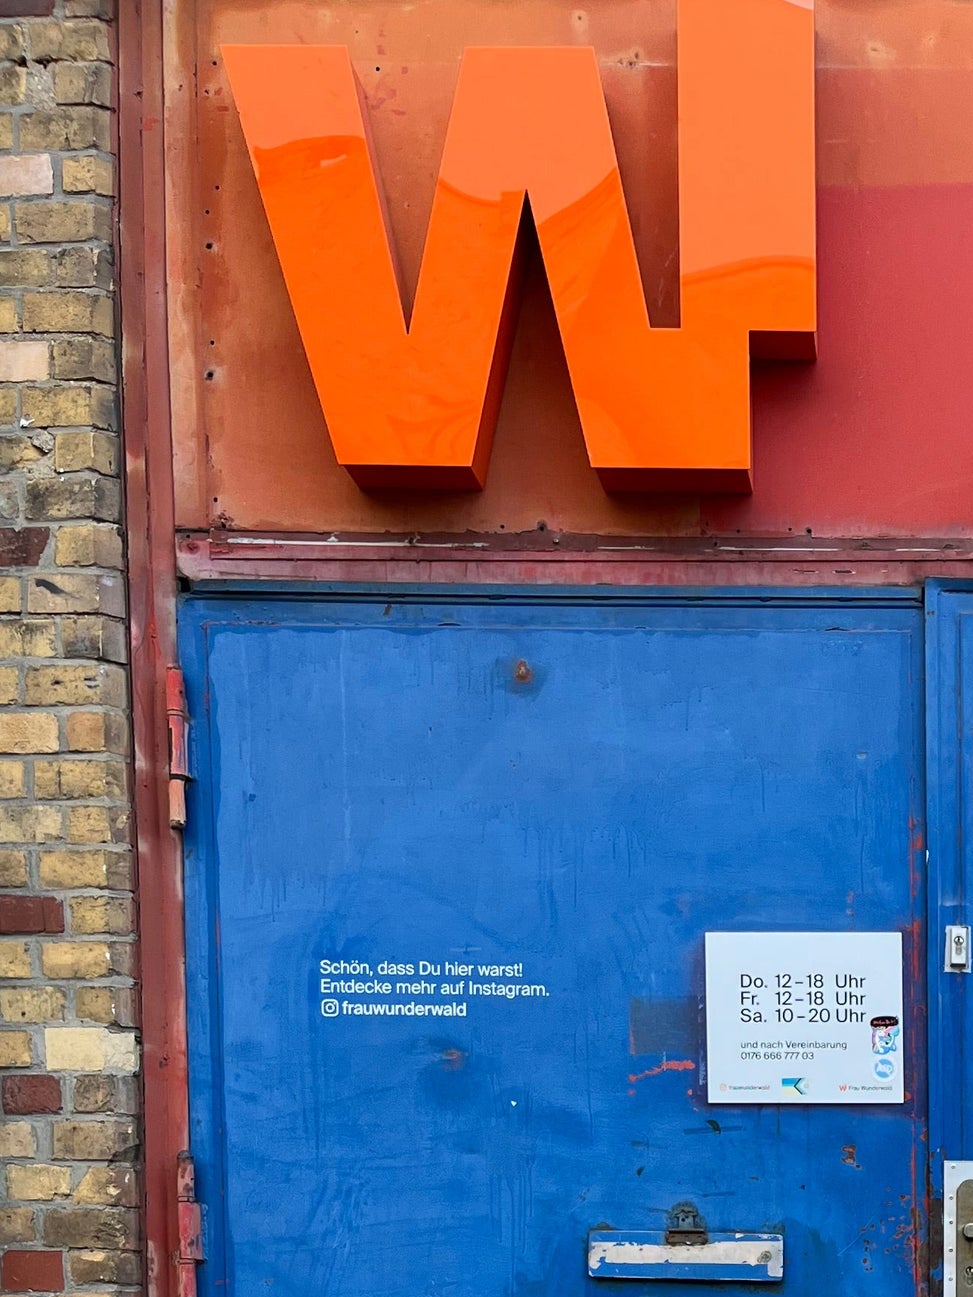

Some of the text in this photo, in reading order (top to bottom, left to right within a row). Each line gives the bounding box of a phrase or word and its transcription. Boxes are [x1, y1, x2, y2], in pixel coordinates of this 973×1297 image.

[320, 960, 522, 976] Schön, dass Du hier warst!
[741, 974, 767, 988] Do.
[836, 974, 866, 988] Uhr
[321, 979, 549, 998] Entdecke mehr auf Instagram.
[741, 991, 759, 1005] Fr.
[836, 991, 866, 1005] Uhr
[342, 1001, 466, 1016] frauwunderwald
[741, 1008, 767, 1023] Sa.
[836, 1009, 866, 1022] Uhr
[740, 1041, 848, 1050] und nach Vereinbarung
[740, 1052, 815, 1060] 0176 666 777 03
